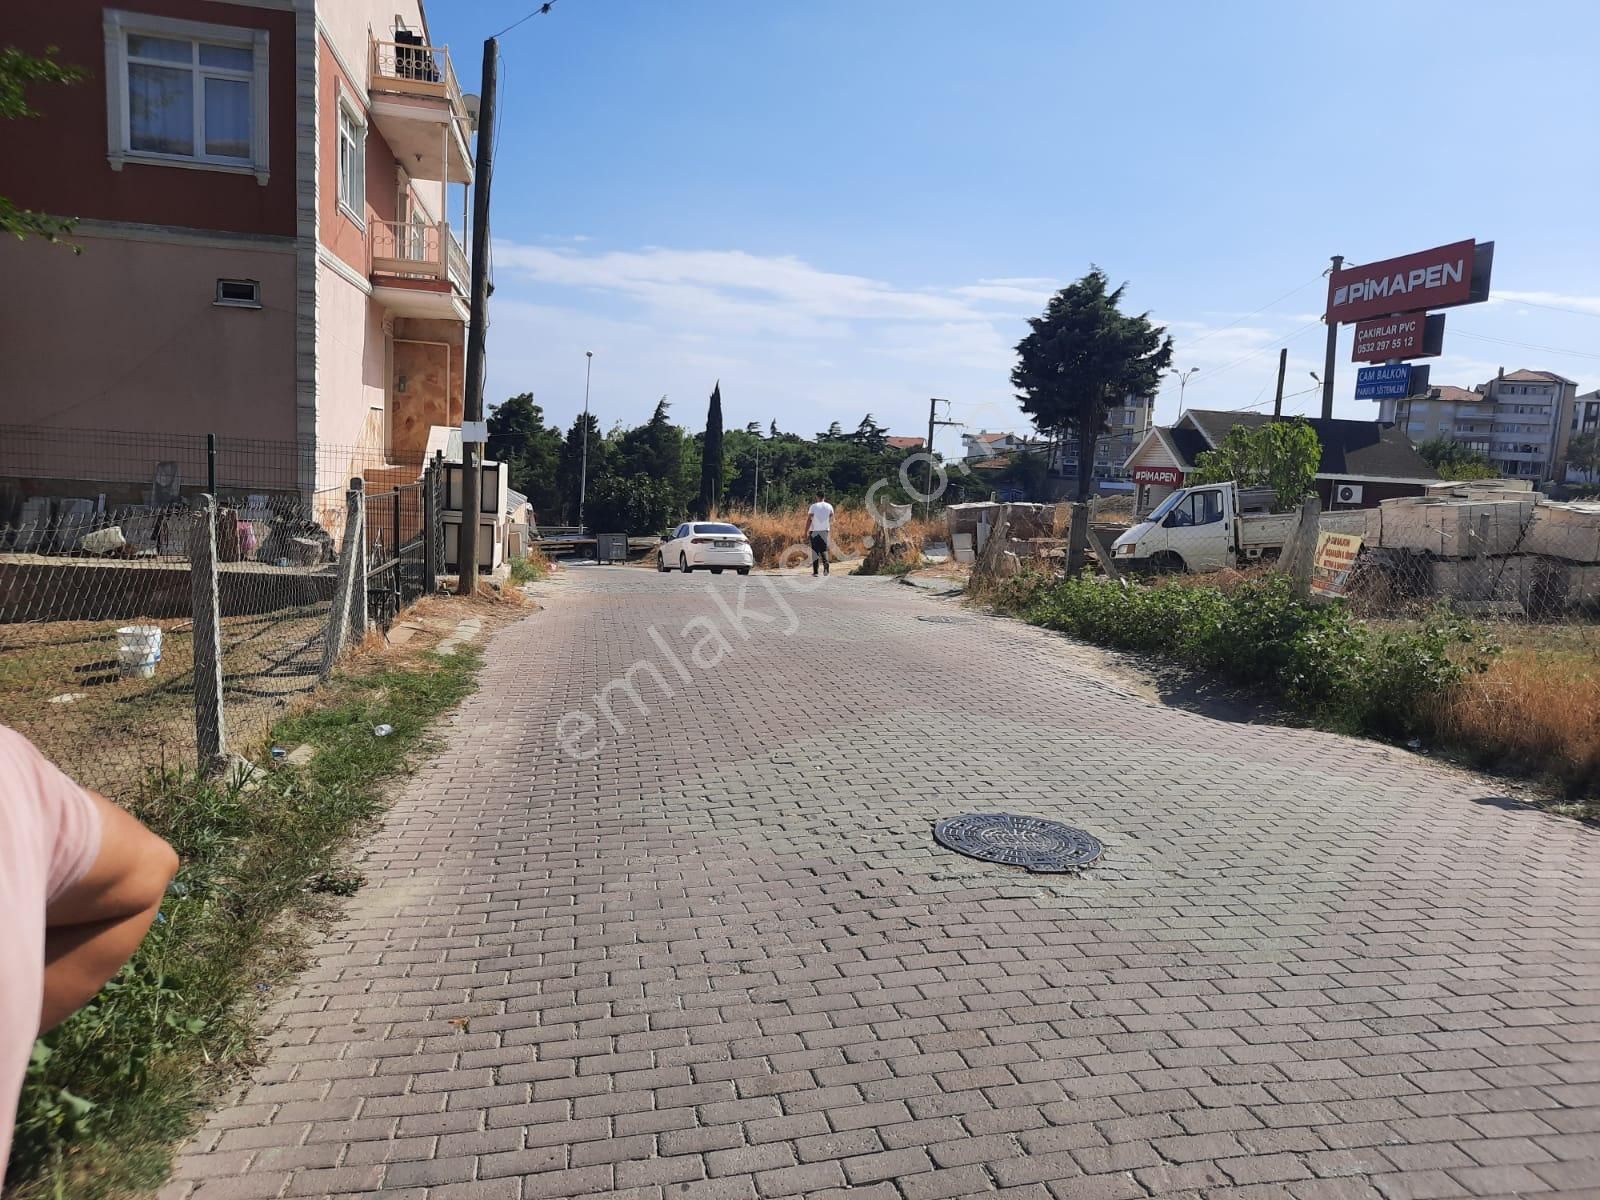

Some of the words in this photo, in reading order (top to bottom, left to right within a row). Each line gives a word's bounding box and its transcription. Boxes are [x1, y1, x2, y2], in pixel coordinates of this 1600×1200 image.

[1348, 259, 1463, 304] PİMAPEN
[1399, 321, 1416, 334] PVC
[1357, 342, 1375, 354] 0532
[1376, 340, 1389, 351] 297
[1391, 338, 1401, 349] 55
[1404, 336, 1414, 347] 12
[1359, 370, 1375, 382] CAM
[1376, 367, 1407, 380] BALKON
